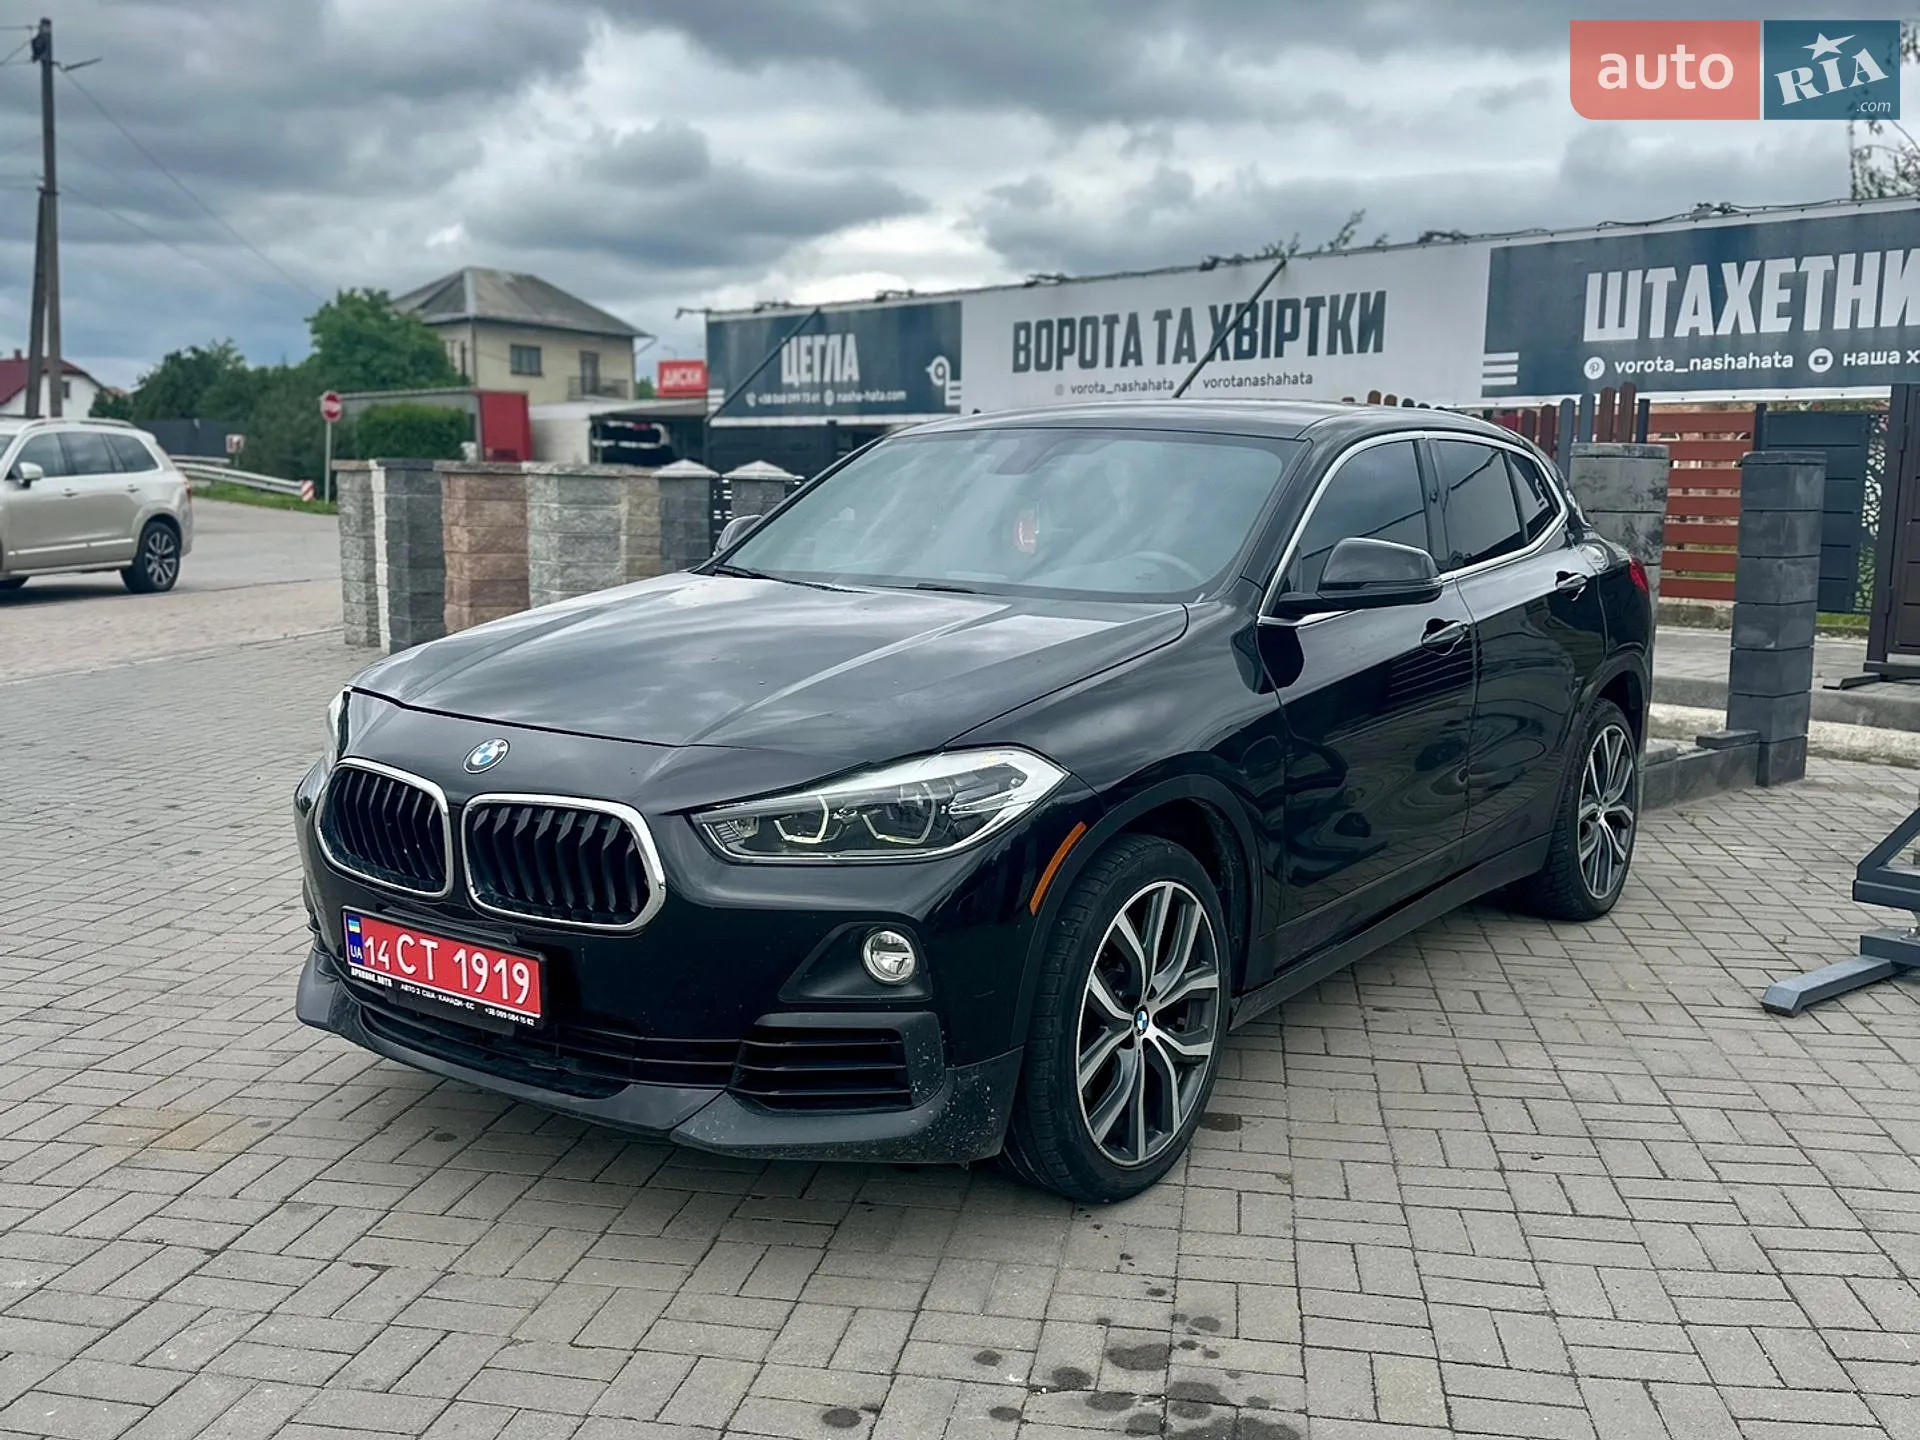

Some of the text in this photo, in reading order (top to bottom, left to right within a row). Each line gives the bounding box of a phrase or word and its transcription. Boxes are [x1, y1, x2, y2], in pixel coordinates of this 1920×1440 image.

[1583, 248, 1920, 342] ШТАХЕТНИ
[1012, 290, 1387, 373] ВОРОТА ТА ХВІРТКИ
[781, 333, 860, 387] ЦЕГЛА
[1614, 351, 1794, 374] vorota_nashahata
[1842, 350, 1901, 367] наша
[1070, 378, 1175, 395] vorota_nashahata
[1203, 372, 1313, 389] vorotanashahata
[350, 944, 363, 960] UA
[453, 948, 530, 1005] 1919
